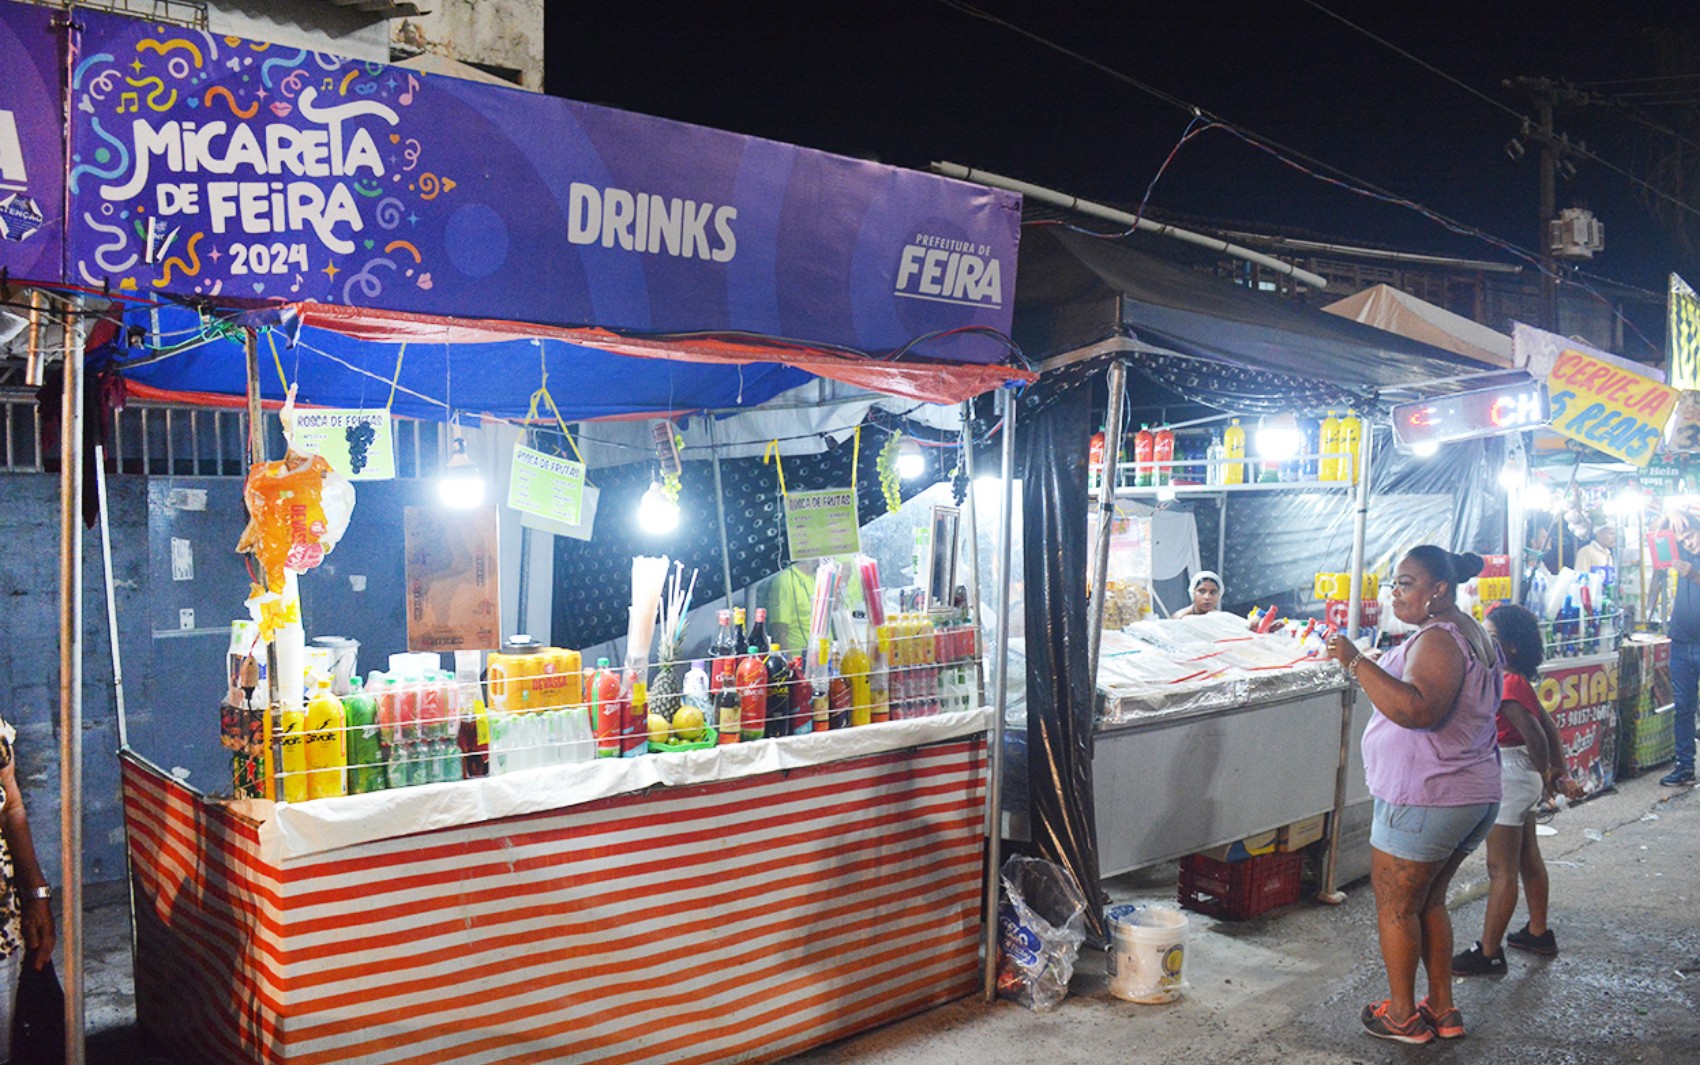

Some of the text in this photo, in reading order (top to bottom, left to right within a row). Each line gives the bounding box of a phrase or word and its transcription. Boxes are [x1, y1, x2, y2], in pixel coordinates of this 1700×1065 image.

[156, 183, 200, 215] DE
[568, 182, 737, 262] DRINKS
[229, 243, 309, 275] 2024
[915, 234, 992, 257] PREFEITURA DE
[896, 244, 1001, 304] FEIRA
[1551, 351, 1671, 418] CERVEJA
[297, 414, 328, 428] ROSCA
[330, 414, 343, 427] DE
[1564, 398, 1661, 458] REAIS
[823, 494, 851, 507] FRUTAS
[532, 674, 568, 691] DEVASSA
